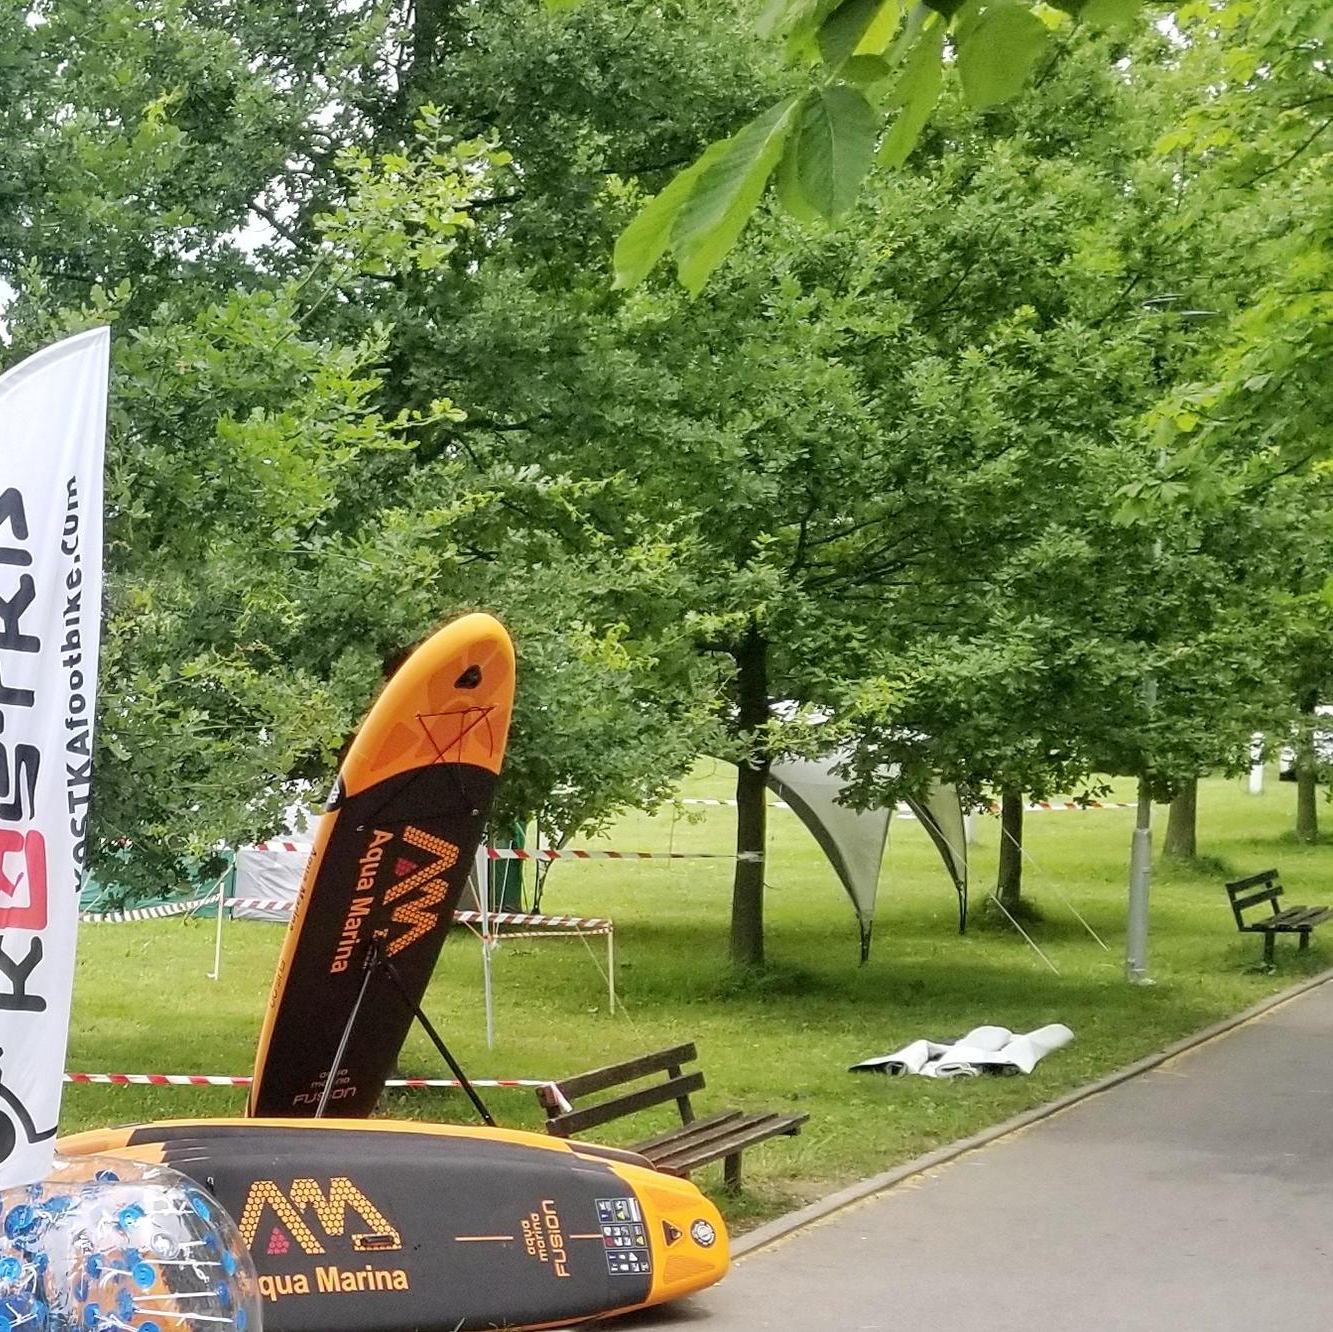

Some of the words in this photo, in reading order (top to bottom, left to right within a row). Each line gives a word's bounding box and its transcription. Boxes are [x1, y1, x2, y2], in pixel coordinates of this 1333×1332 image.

[356, 828, 394, 890] Aqua
[330, 895, 376, 974] Marina
[521, 1220, 536, 1256] aqua
[530, 1213, 549, 1262] marina
[541, 1199, 571, 1277] FUSION
[258, 1273, 310, 1301] qua
[315, 1265, 409, 1292] Marina
